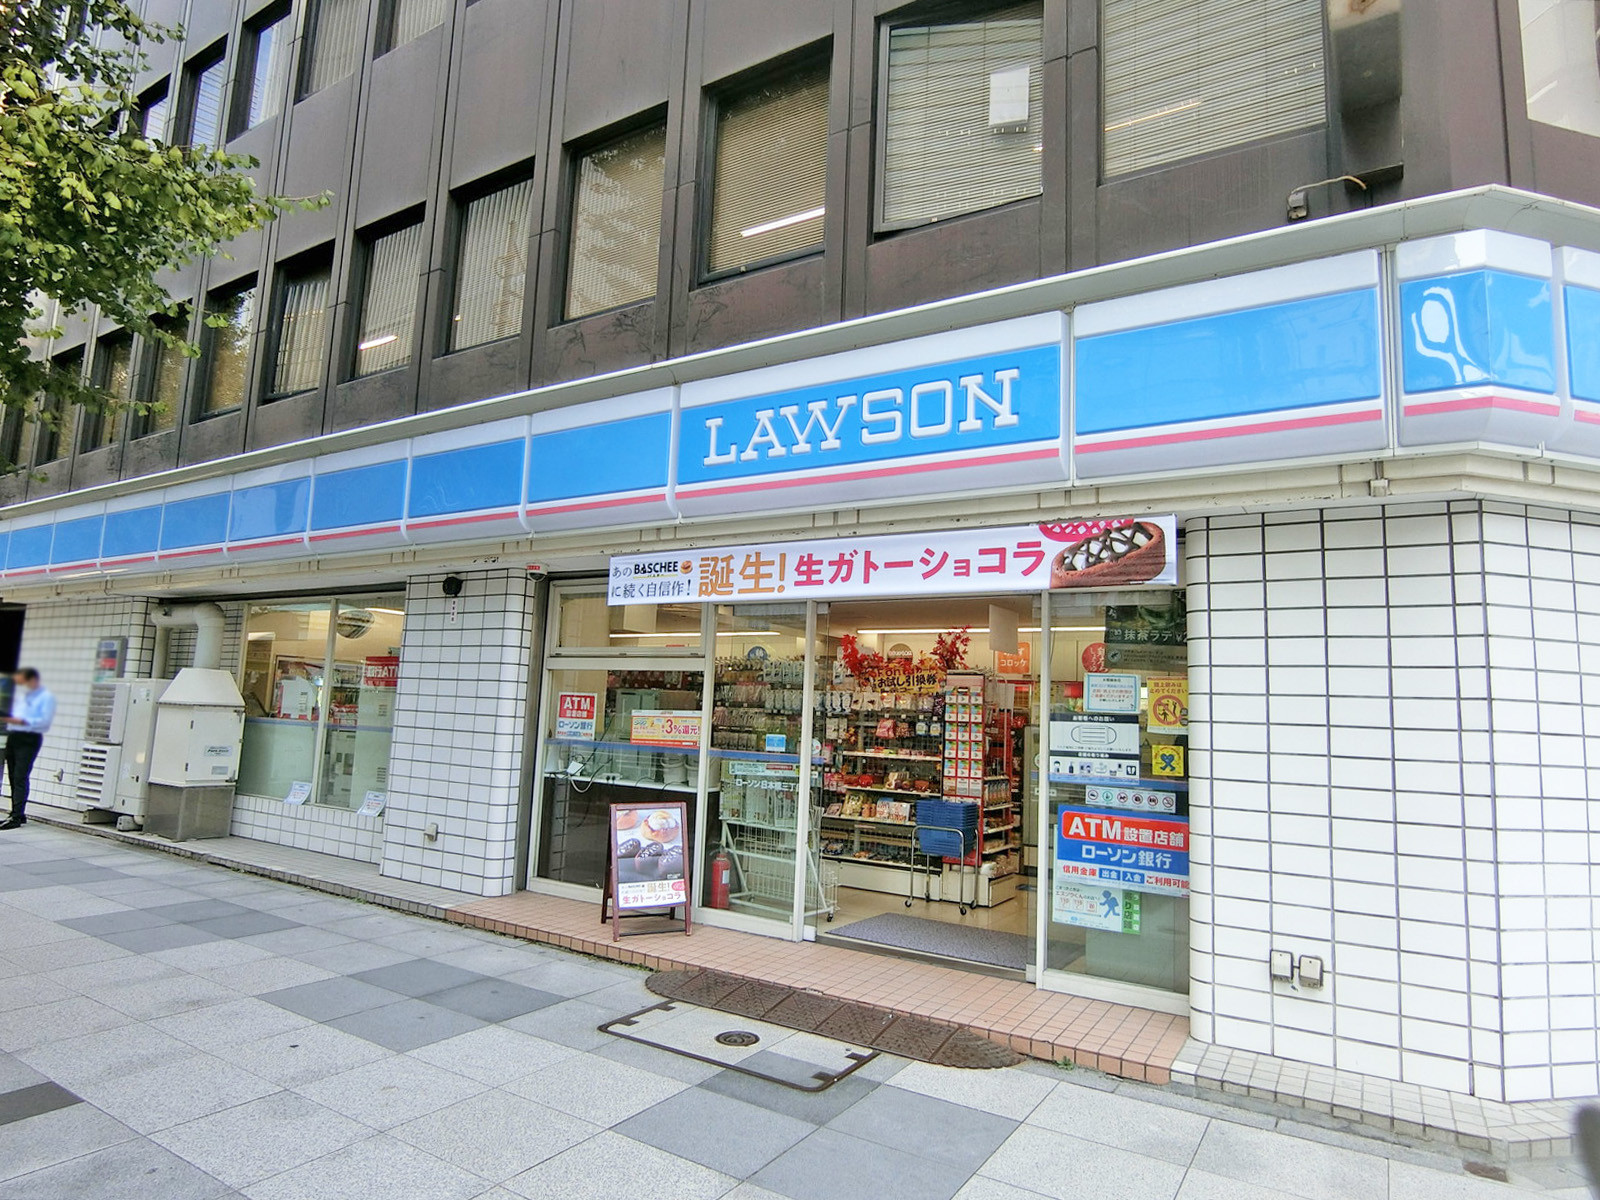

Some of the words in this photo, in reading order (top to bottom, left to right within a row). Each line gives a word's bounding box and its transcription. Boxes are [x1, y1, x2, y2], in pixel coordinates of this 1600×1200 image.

[702, 367, 1020, 467] LAWSON
[793, 540, 1047, 587] 生ガトーショコラ
[1124, 629, 1172, 641] 抹茶ラテ
[1000, 658, 1026, 667] コロッケ
[878, 673, 937, 687] お試し引換券
[563, 696, 591, 710] ATM
[1081, 844, 1173, 869] ローソン銀行
[1062, 864, 1097, 877] 信用金庫
[1101, 869, 1118, 879] 出金
[622, 891, 682, 904] 生ガトーショコラ
